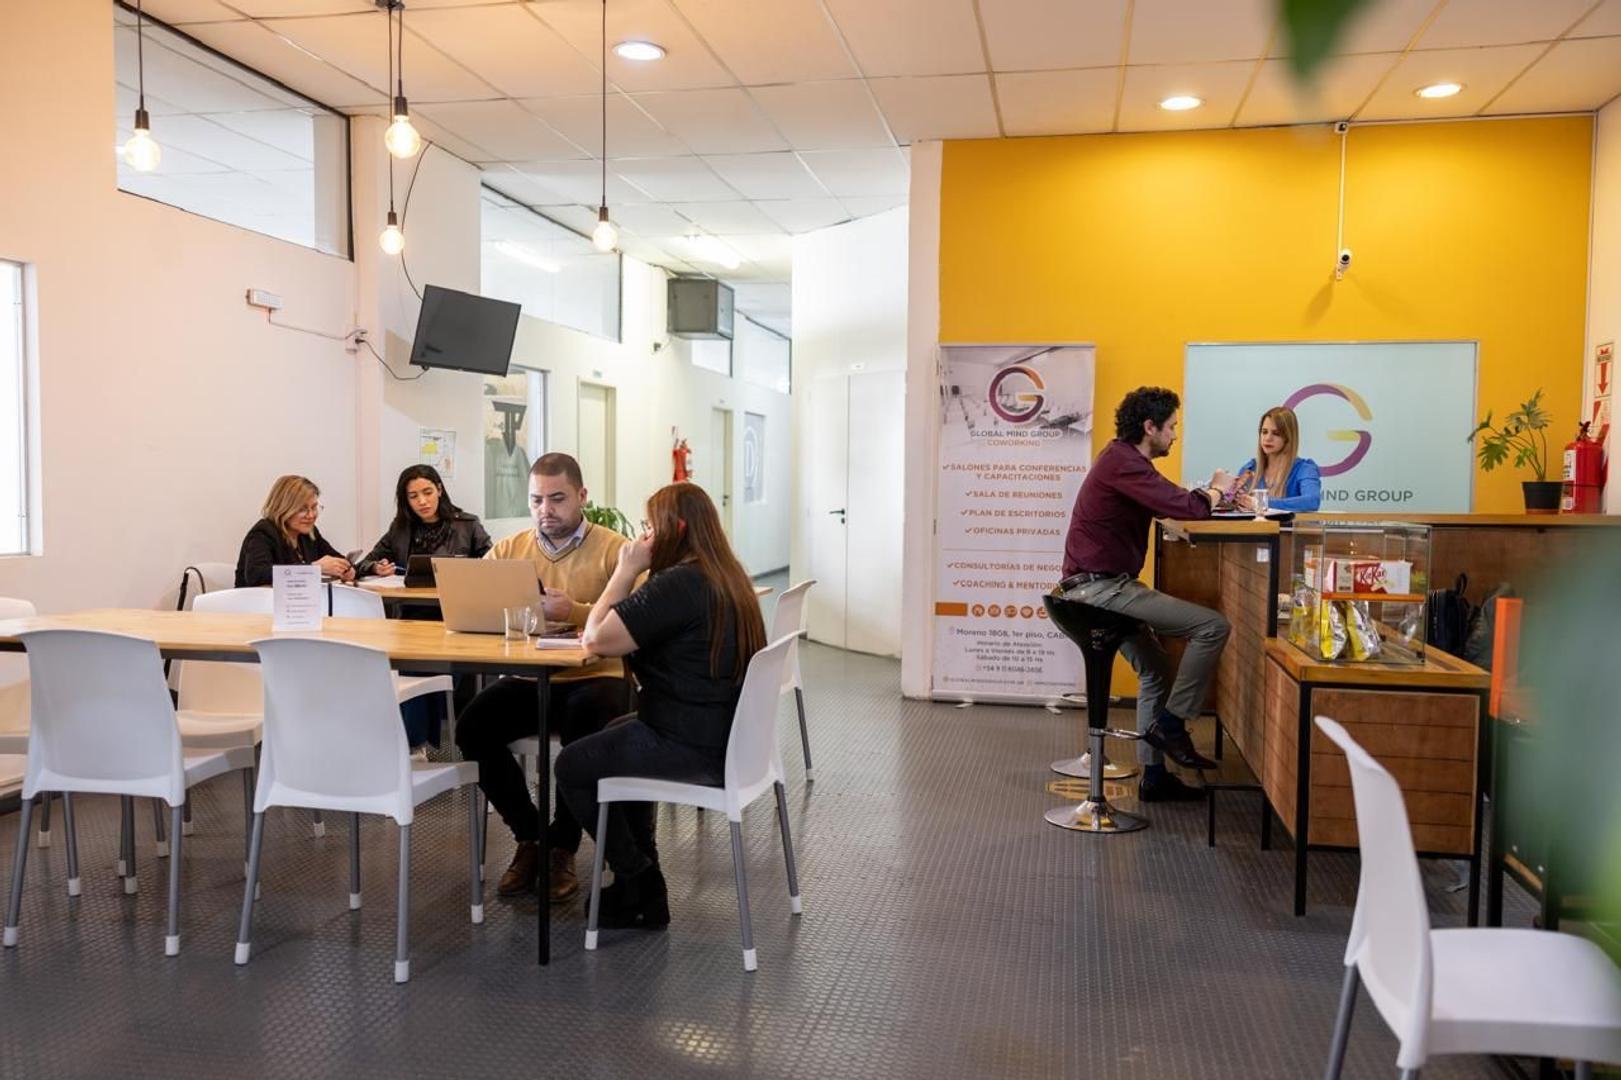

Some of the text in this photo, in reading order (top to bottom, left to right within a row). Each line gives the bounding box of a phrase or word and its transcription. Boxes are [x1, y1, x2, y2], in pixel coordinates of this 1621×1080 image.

[970, 430, 1060, 439] GLOBAL MIND GROUP
[987, 439, 1041, 447] COWORKING
[951, 464, 1087, 473] SALONES PARA CONFERENCIAS
[983, 473, 1062, 482] CAPACITACIONES
[1012, 491, 1063, 500] REUNIONES
[1321, 489, 1414, 502] IND GROUP
[969, 509, 1066, 518] PLAN DE ESCRITORIOS
[973, 527, 1061, 536] OFICINAS PRIVADAS
[1023, 563, 1035, 571] DE
[1036, 564, 1062, 572] NEGO
[960, 580, 1006, 589] COACHING
[956, 629, 987, 637] Moreno
[1012, 630, 1023, 638] 1er
[1025, 631, 1045, 640] piso,
[1046, 631, 1065, 639] CAB
